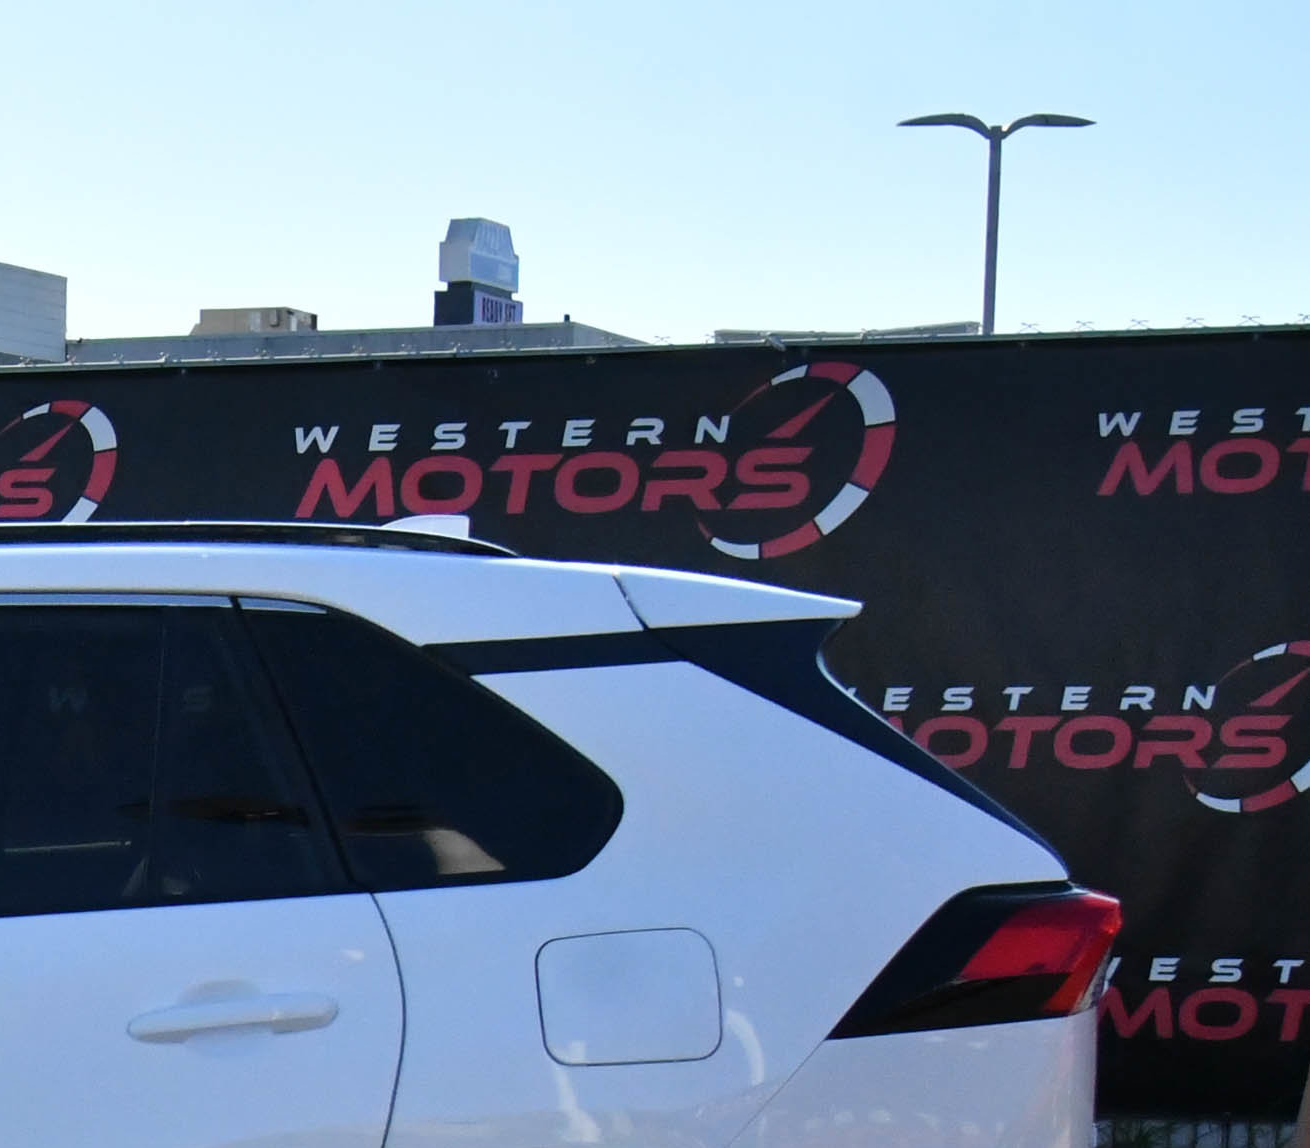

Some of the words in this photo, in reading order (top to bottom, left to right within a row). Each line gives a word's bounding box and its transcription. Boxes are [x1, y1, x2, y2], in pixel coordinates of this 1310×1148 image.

[296, 415, 730, 454] WESTERN
[295, 447, 813, 518] MOTORS
[880, 685, 1216, 712] ESTERN
[884, 715, 1292, 770] OTORS
